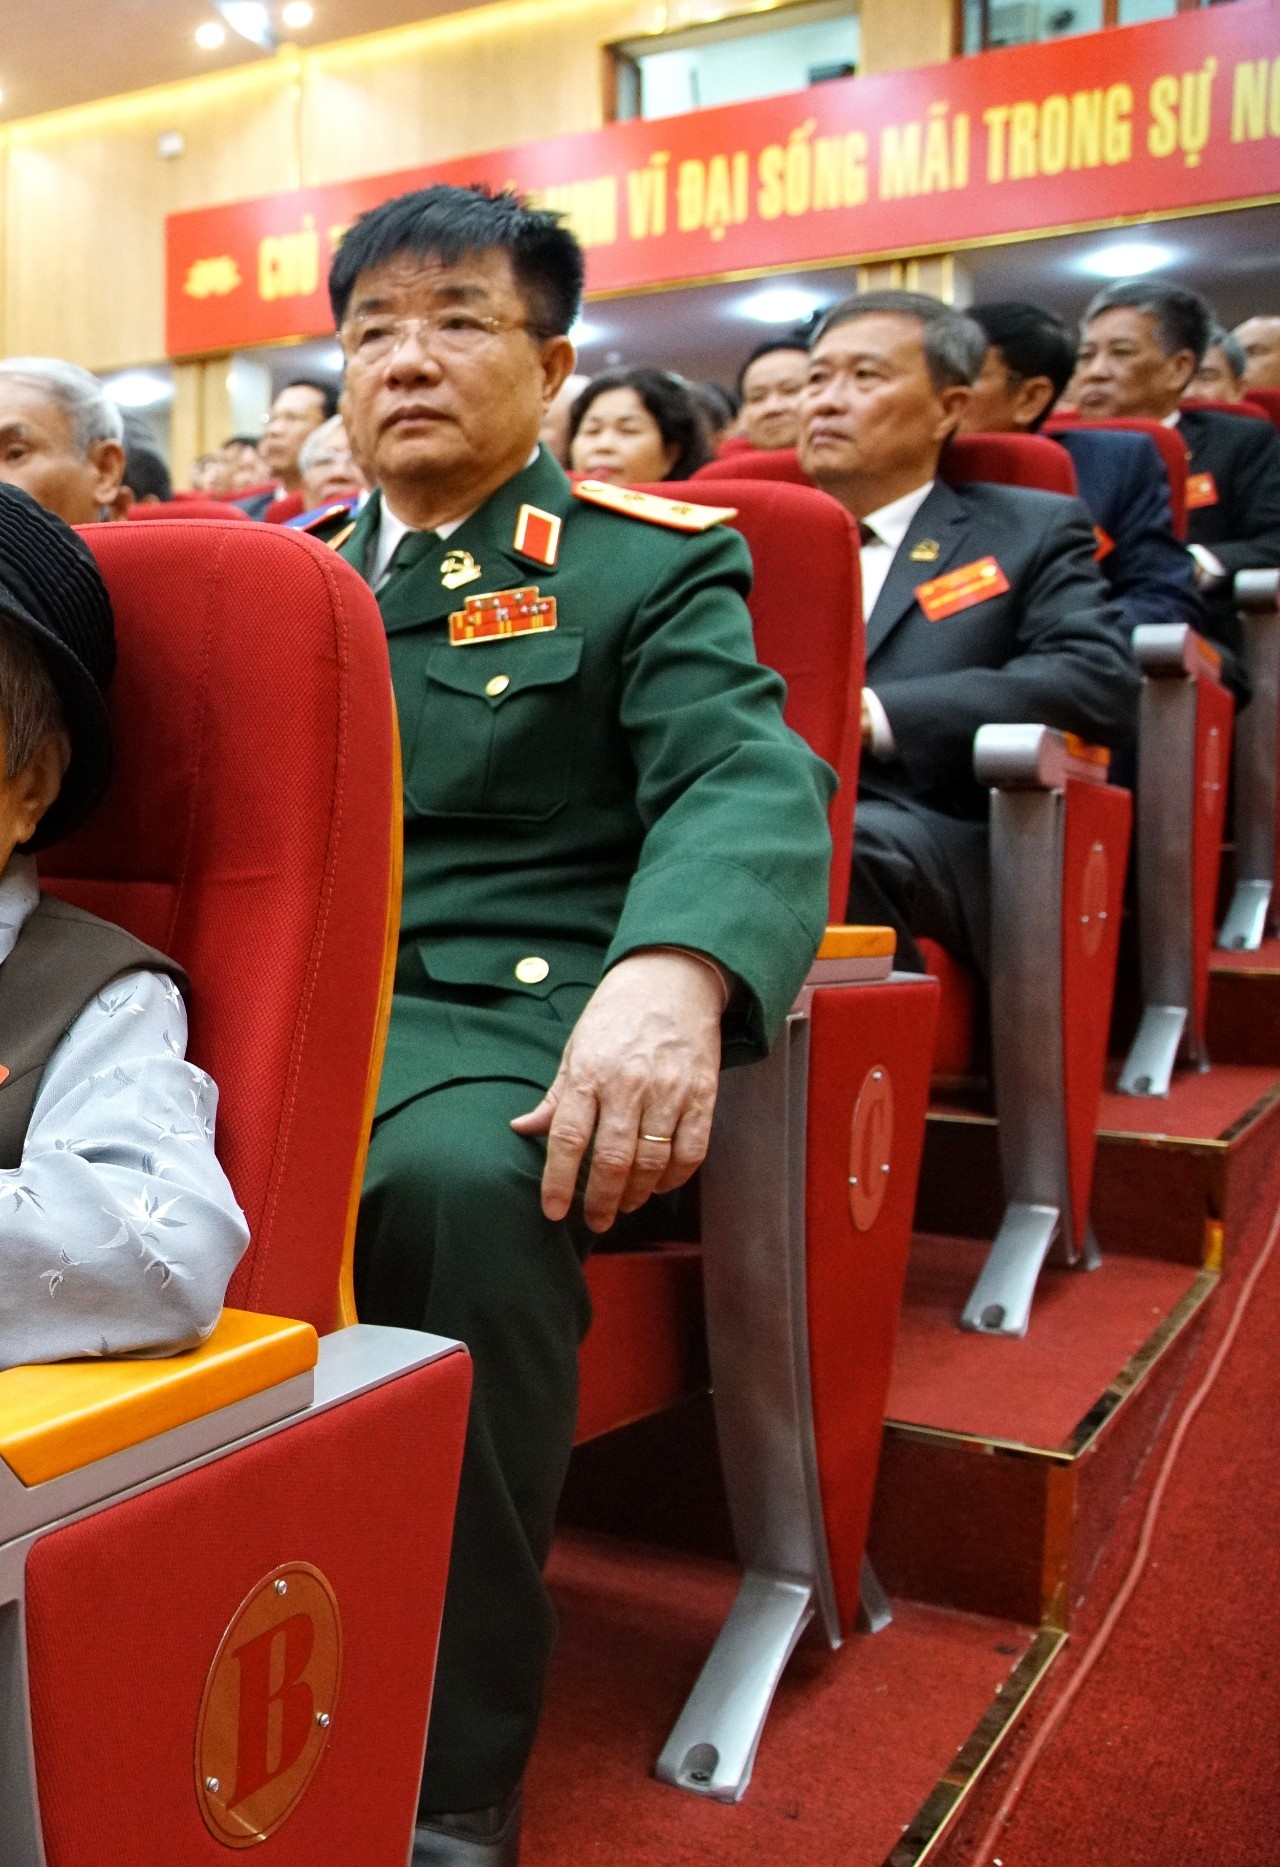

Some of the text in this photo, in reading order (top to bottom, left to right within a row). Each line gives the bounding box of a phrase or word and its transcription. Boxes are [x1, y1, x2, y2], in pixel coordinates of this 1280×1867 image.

[258, 213, 319, 301] CHỦ
[628, 150, 669, 239] VĨ
[677, 150, 749, 242] ĐẠI
[757, 120, 868, 220] SỐNG
[878, 101, 970, 201] MÃI
[982, 82, 1133, 185] TRONG
[1147, 55, 1218, 168] SỰ
[226, 1613, 315, 1812] B
